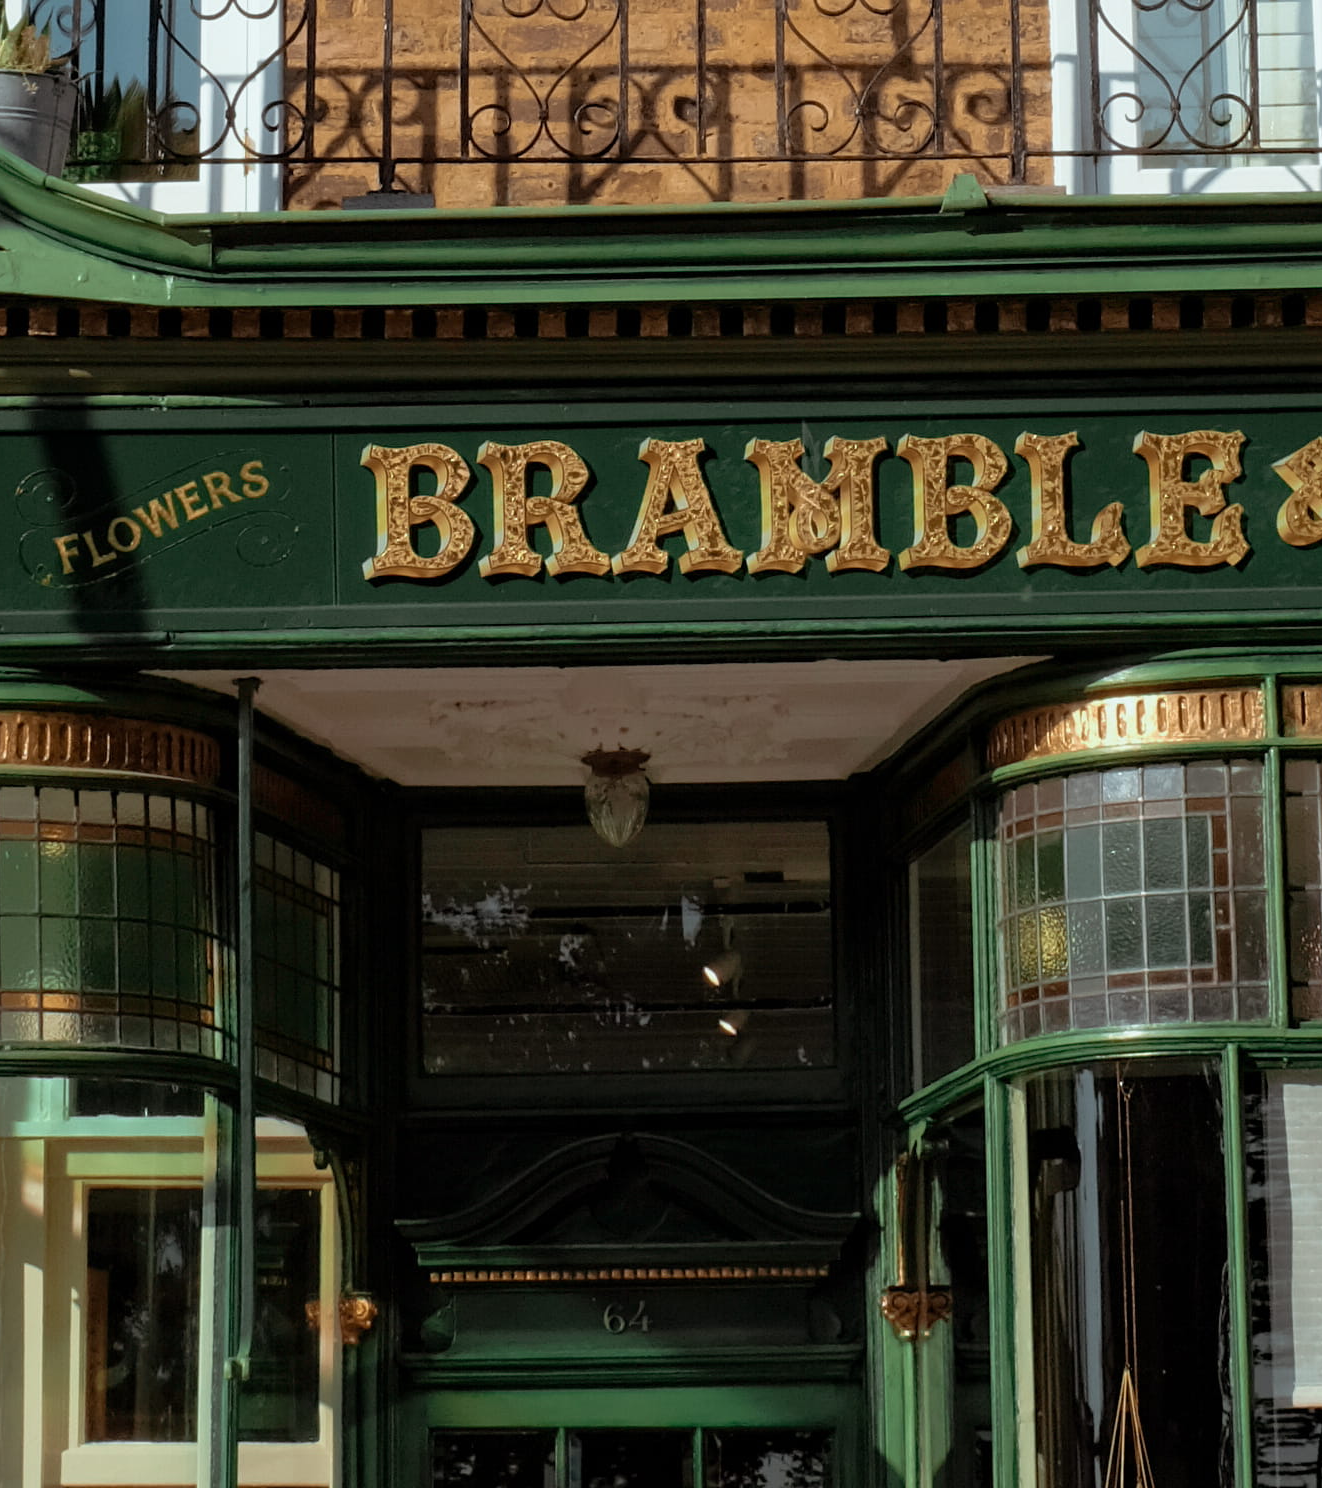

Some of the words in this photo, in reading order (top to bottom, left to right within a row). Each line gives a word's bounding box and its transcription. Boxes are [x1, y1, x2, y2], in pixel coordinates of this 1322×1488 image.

[53, 460, 270, 575] FLOWERS
[359, 429, 1251, 581] BRAMBLE
[603, 1299, 654, 1335] 64
